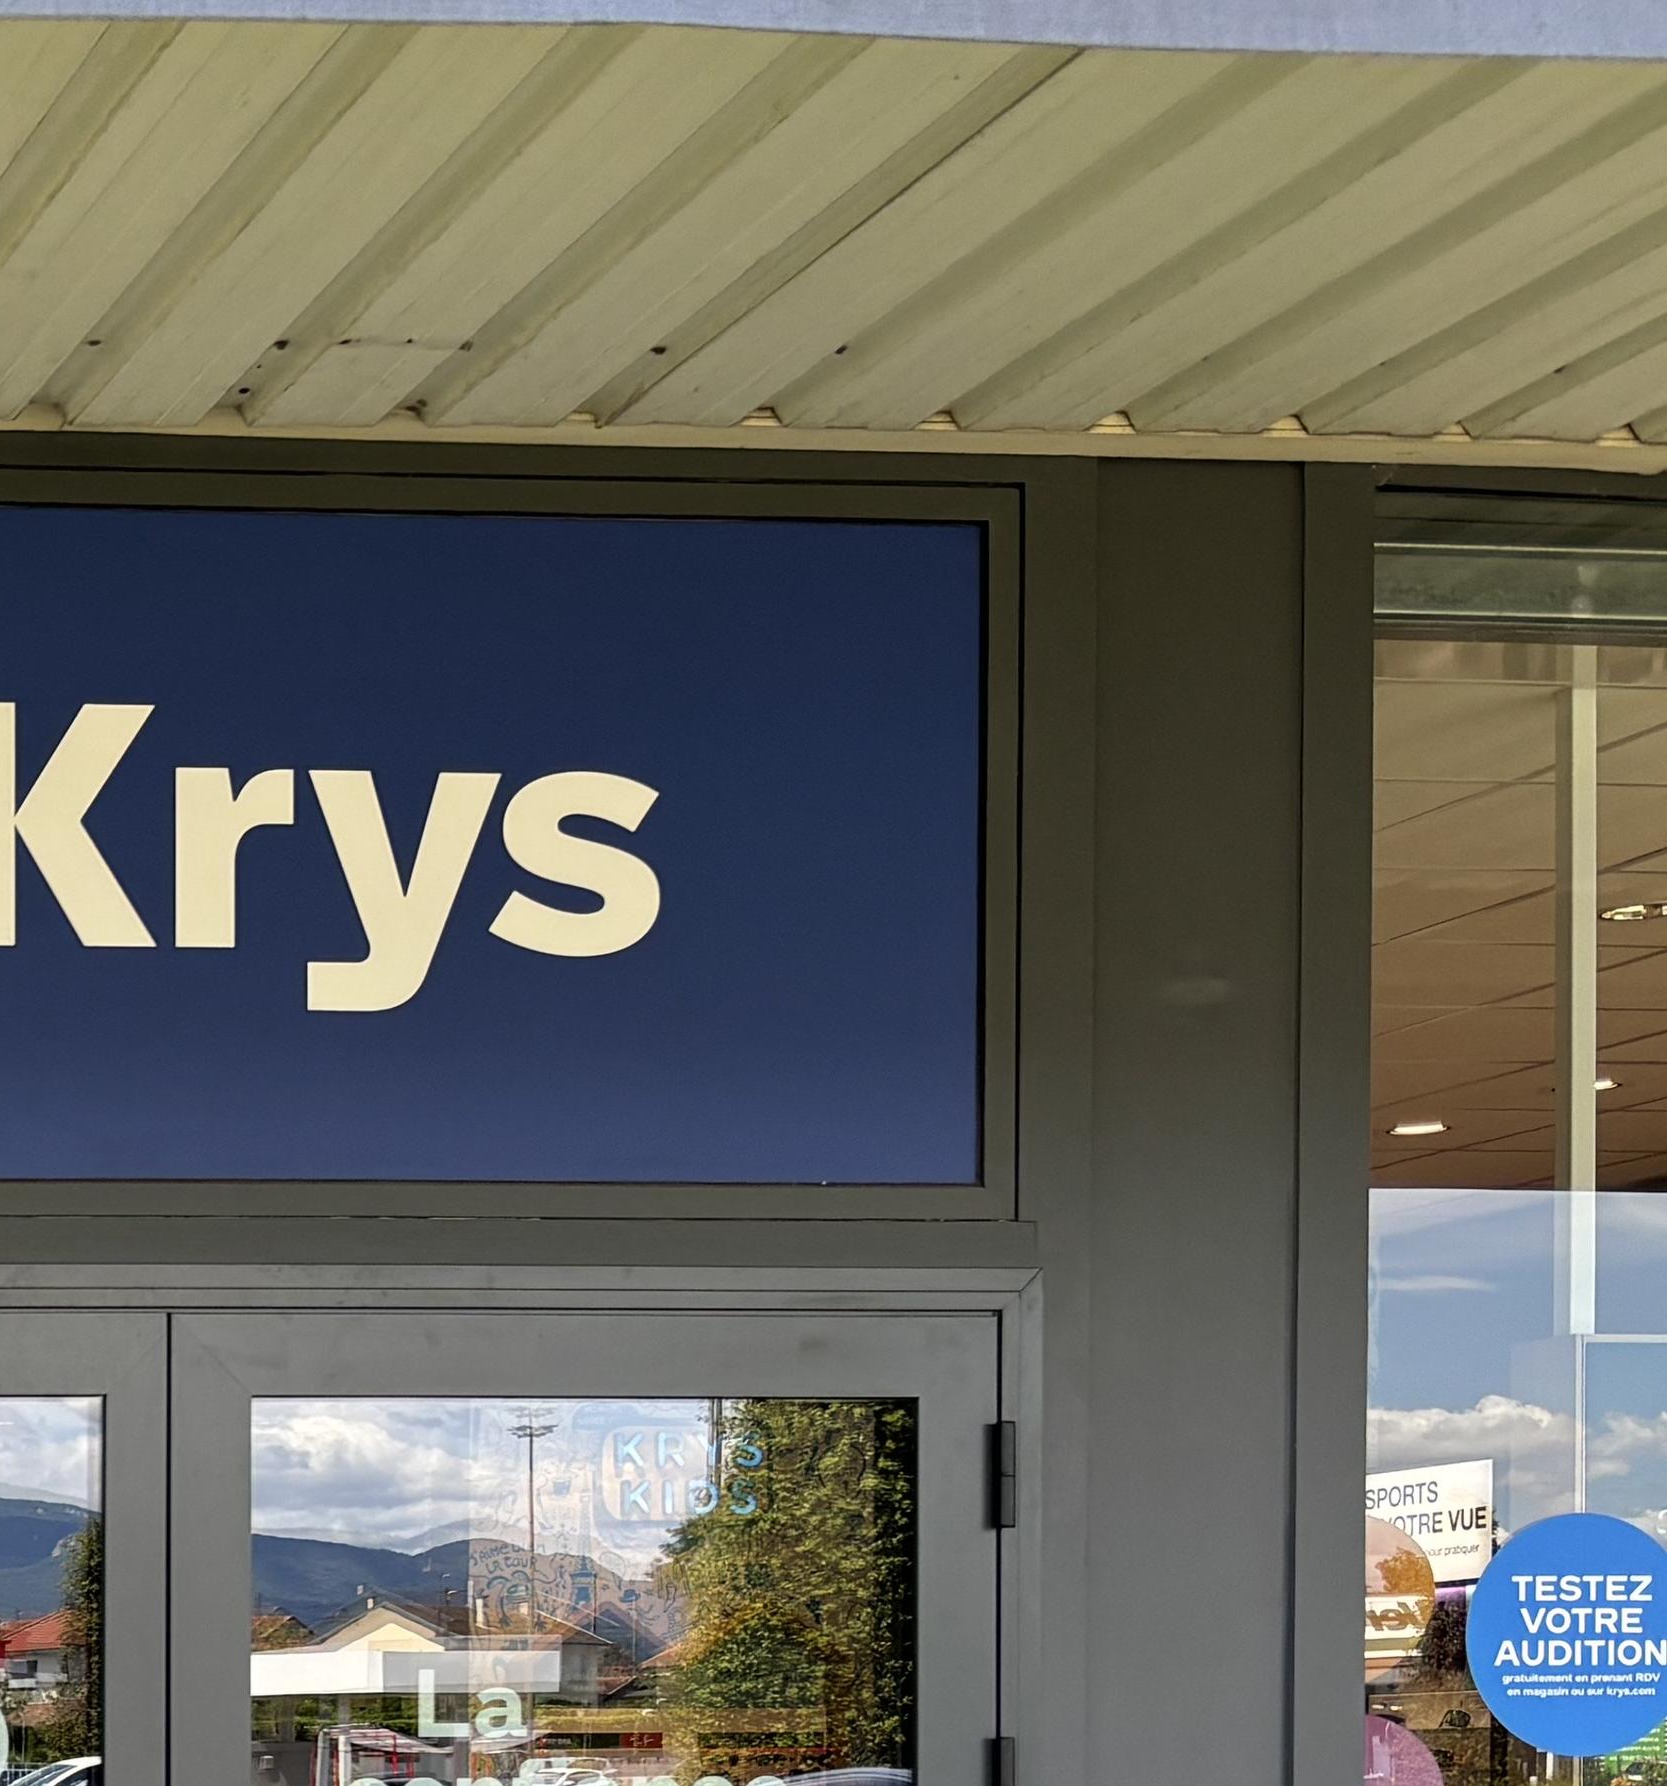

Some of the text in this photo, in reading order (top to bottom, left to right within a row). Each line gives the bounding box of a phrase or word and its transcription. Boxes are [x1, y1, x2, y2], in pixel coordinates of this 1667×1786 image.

[621, 1479, 759, 1515] KIDS
[1365, 1481, 1438, 1510] SPORTS
[1448, 1506, 1487, 1531] VUE
[1511, 1574, 1652, 1601] TESTEZ
[1520, 1607, 1643, 1634] VOTRE
[1494, 1639, 1667, 1667] AUDITION
[1502, 1672, 1660, 1685] gratuitement en prenant RDV
[1507, 1686, 1656, 1698] en magasin ou sur krys.com
[417, 1668, 529, 1740] La
